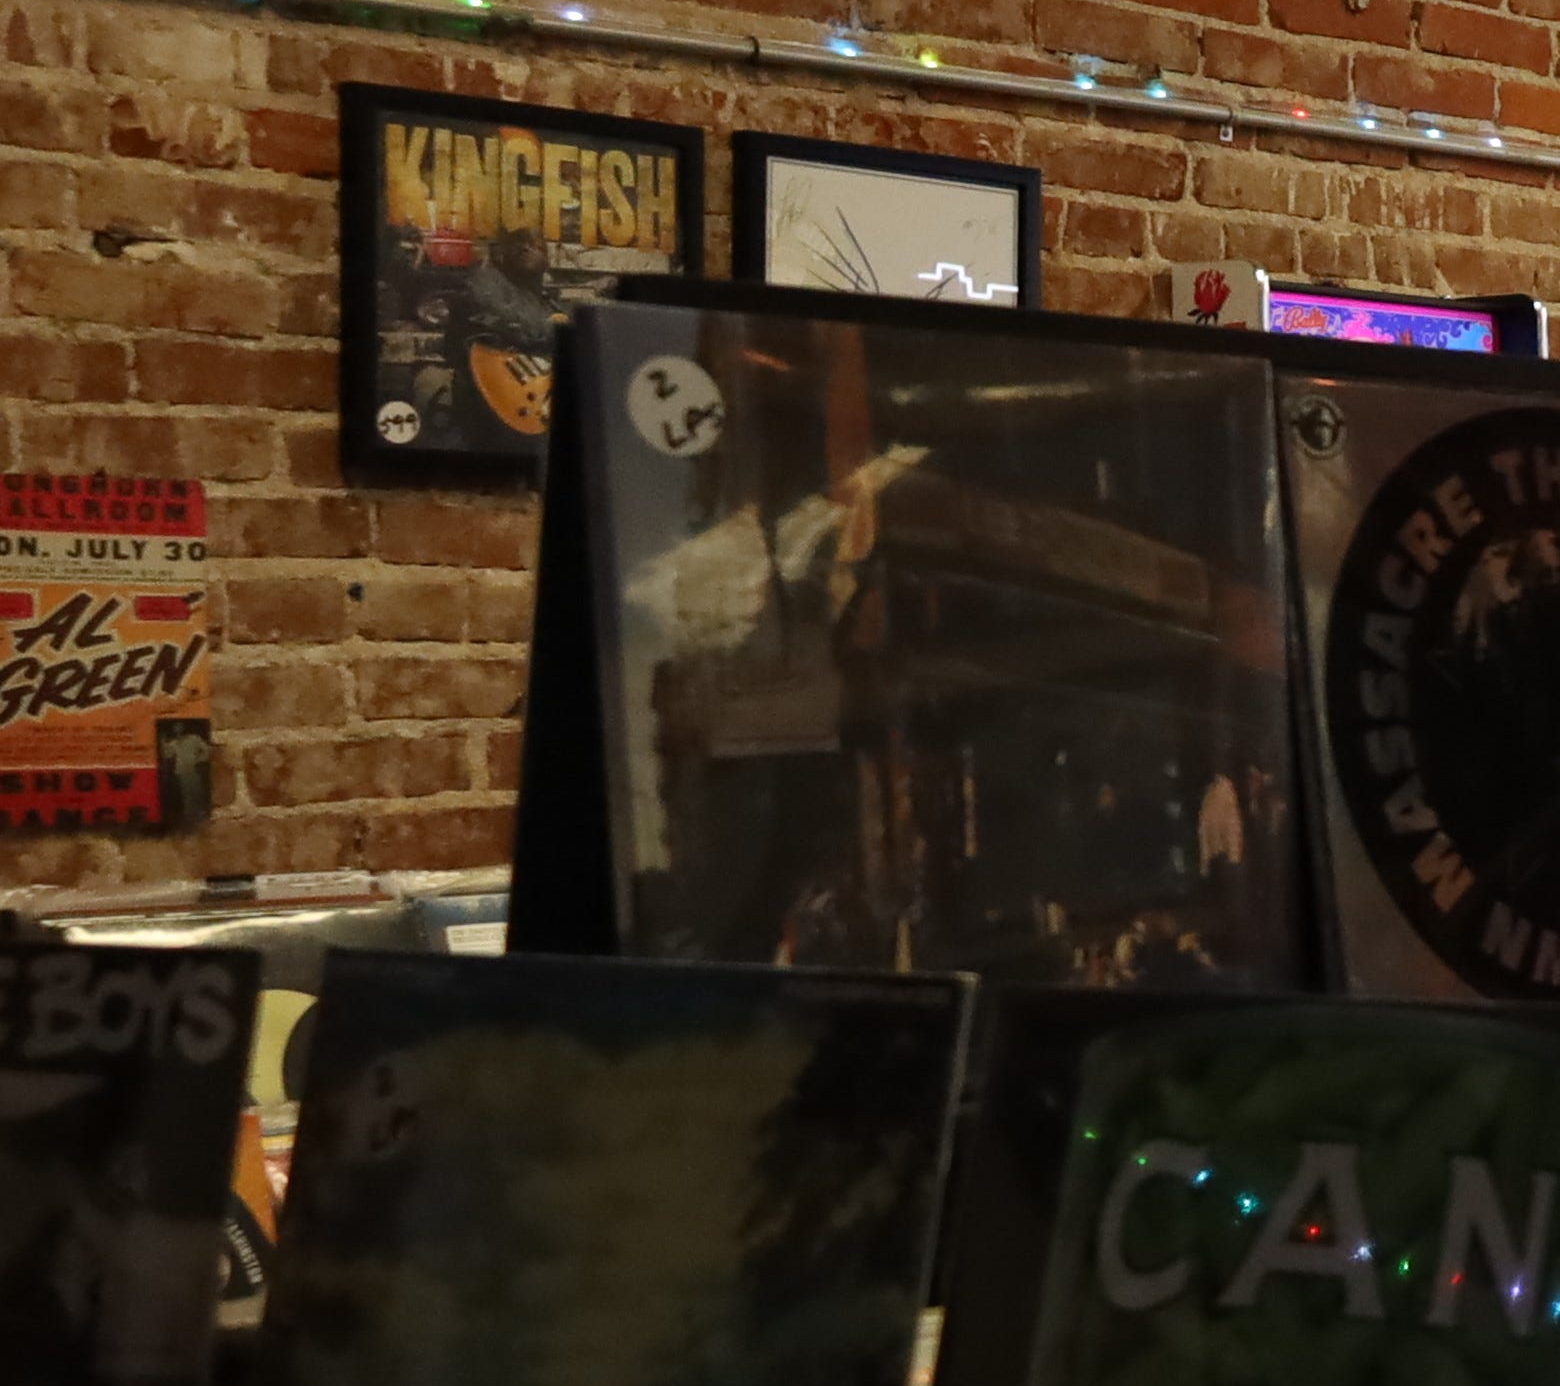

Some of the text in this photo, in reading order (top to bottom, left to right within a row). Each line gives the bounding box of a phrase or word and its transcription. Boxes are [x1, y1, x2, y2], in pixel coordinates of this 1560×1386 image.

[385, 122, 677, 256] KINGFISH
[66, 539, 148, 560] JULY
[163, 541, 207, 562] 30
[13, 591, 123, 654] AL
[0, 633, 205, 726] GREEN
